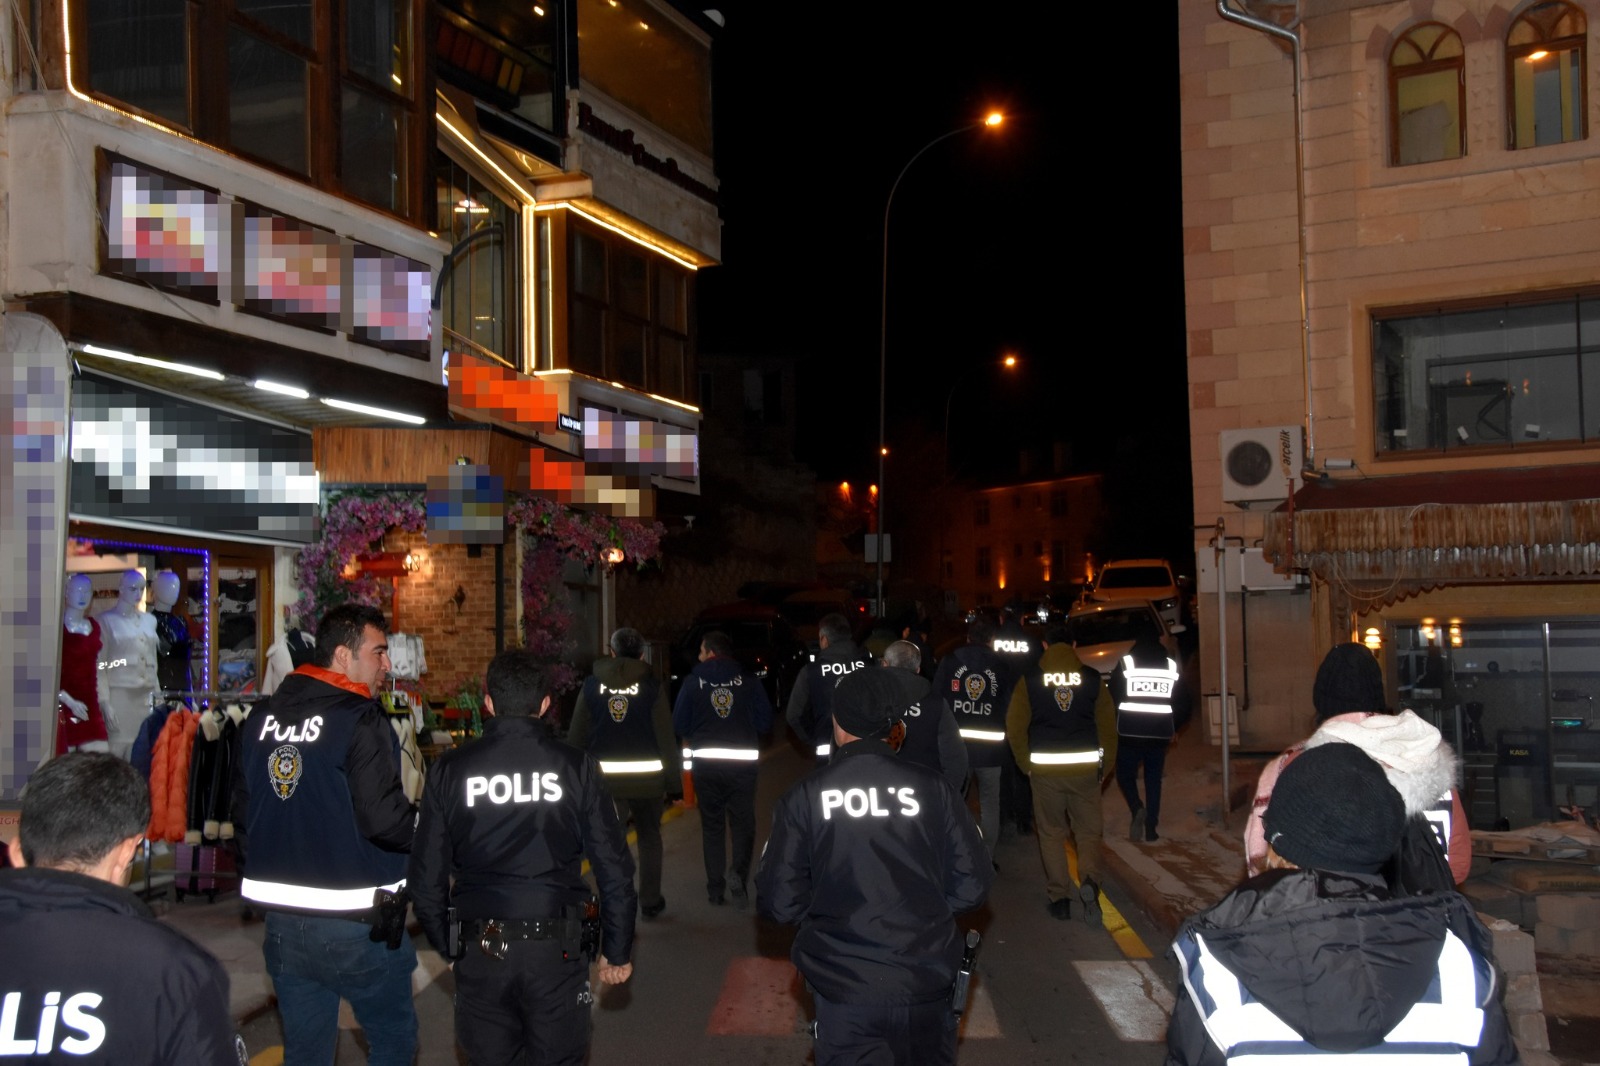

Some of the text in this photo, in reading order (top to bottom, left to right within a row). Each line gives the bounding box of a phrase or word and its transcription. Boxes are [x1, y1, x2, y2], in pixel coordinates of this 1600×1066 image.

[1280, 430, 1292, 466] arçelik
[821, 787, 921, 820] POLS
[0, 991, 106, 1055] LİS
